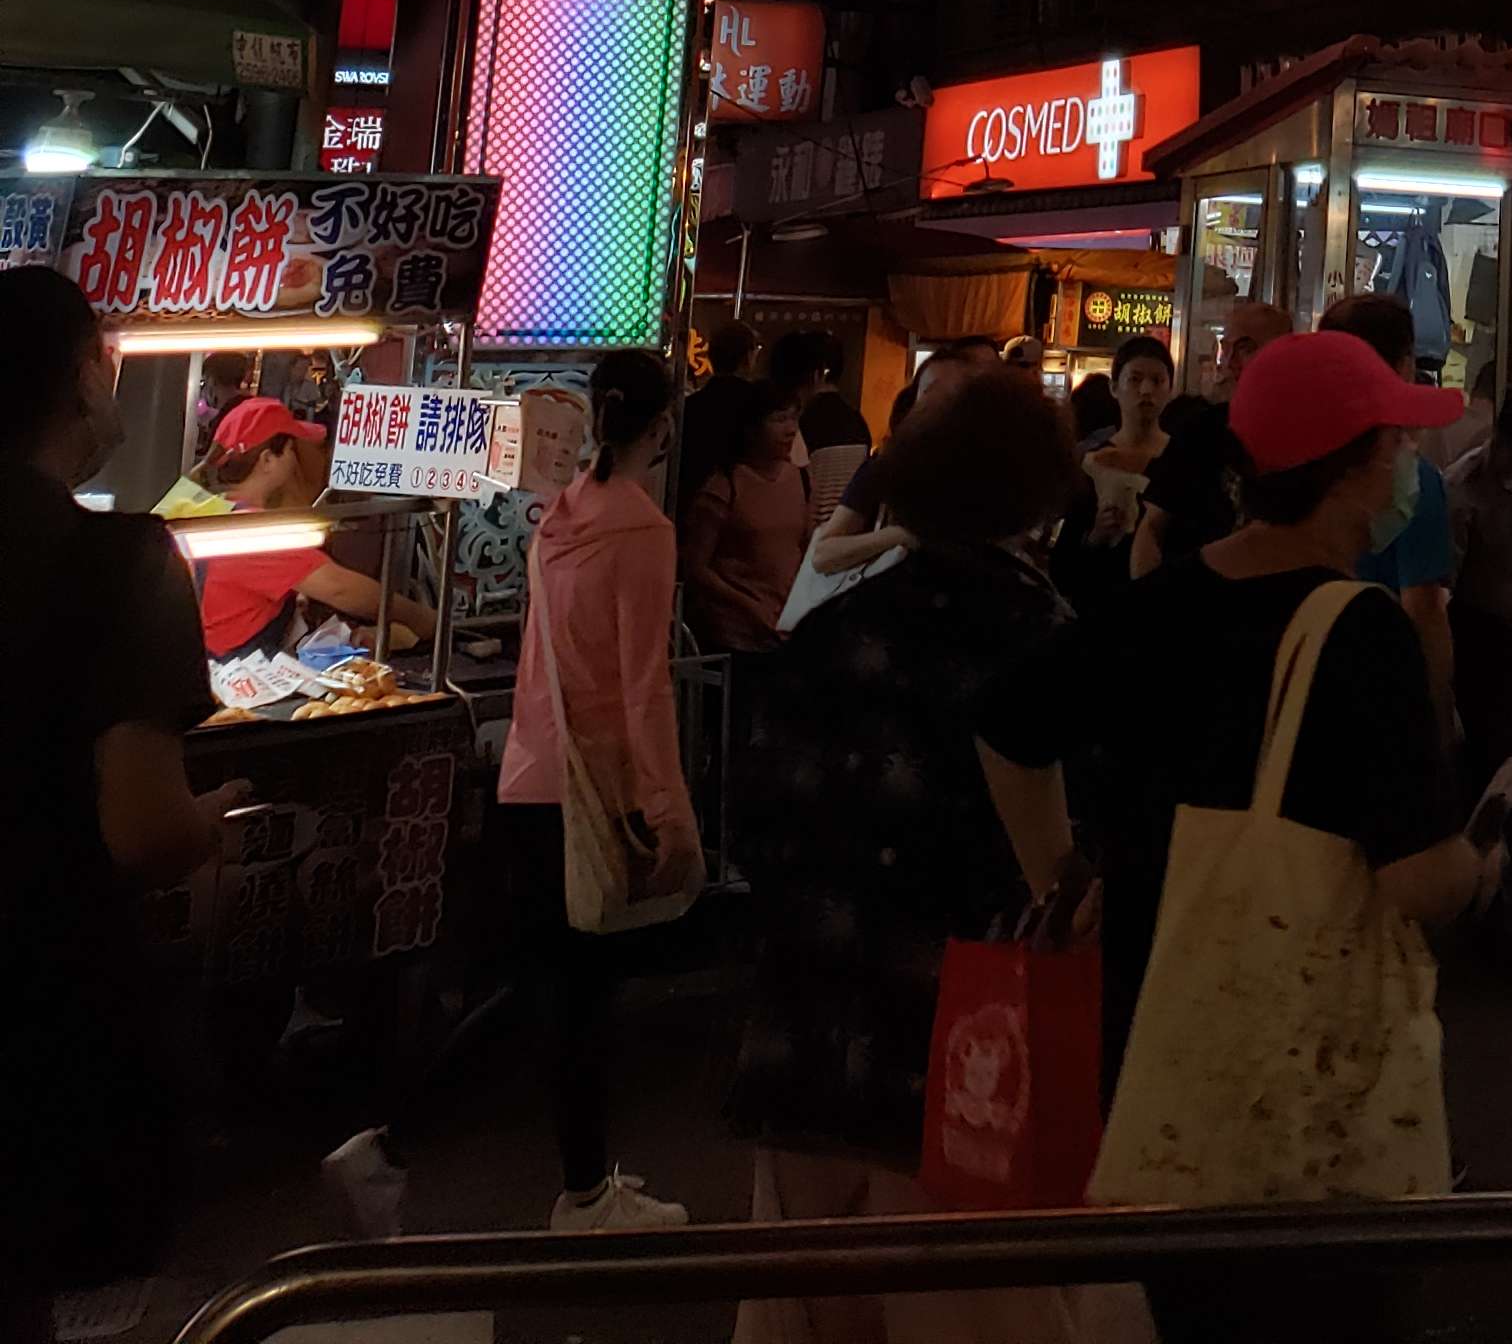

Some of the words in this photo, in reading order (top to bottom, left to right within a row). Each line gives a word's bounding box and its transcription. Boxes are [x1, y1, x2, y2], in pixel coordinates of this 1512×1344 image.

[966, 97, 1086, 162] COSMED
[79, 192, 295, 309] 胡椒餅
[311, 183, 485, 249] 不好吃
[317, 251, 448, 315] 免費
[338, 392, 412, 451] 胡椒餅
[415, 393, 491, 455] 請排隊
[332, 458, 404, 489] 不好吃免費
